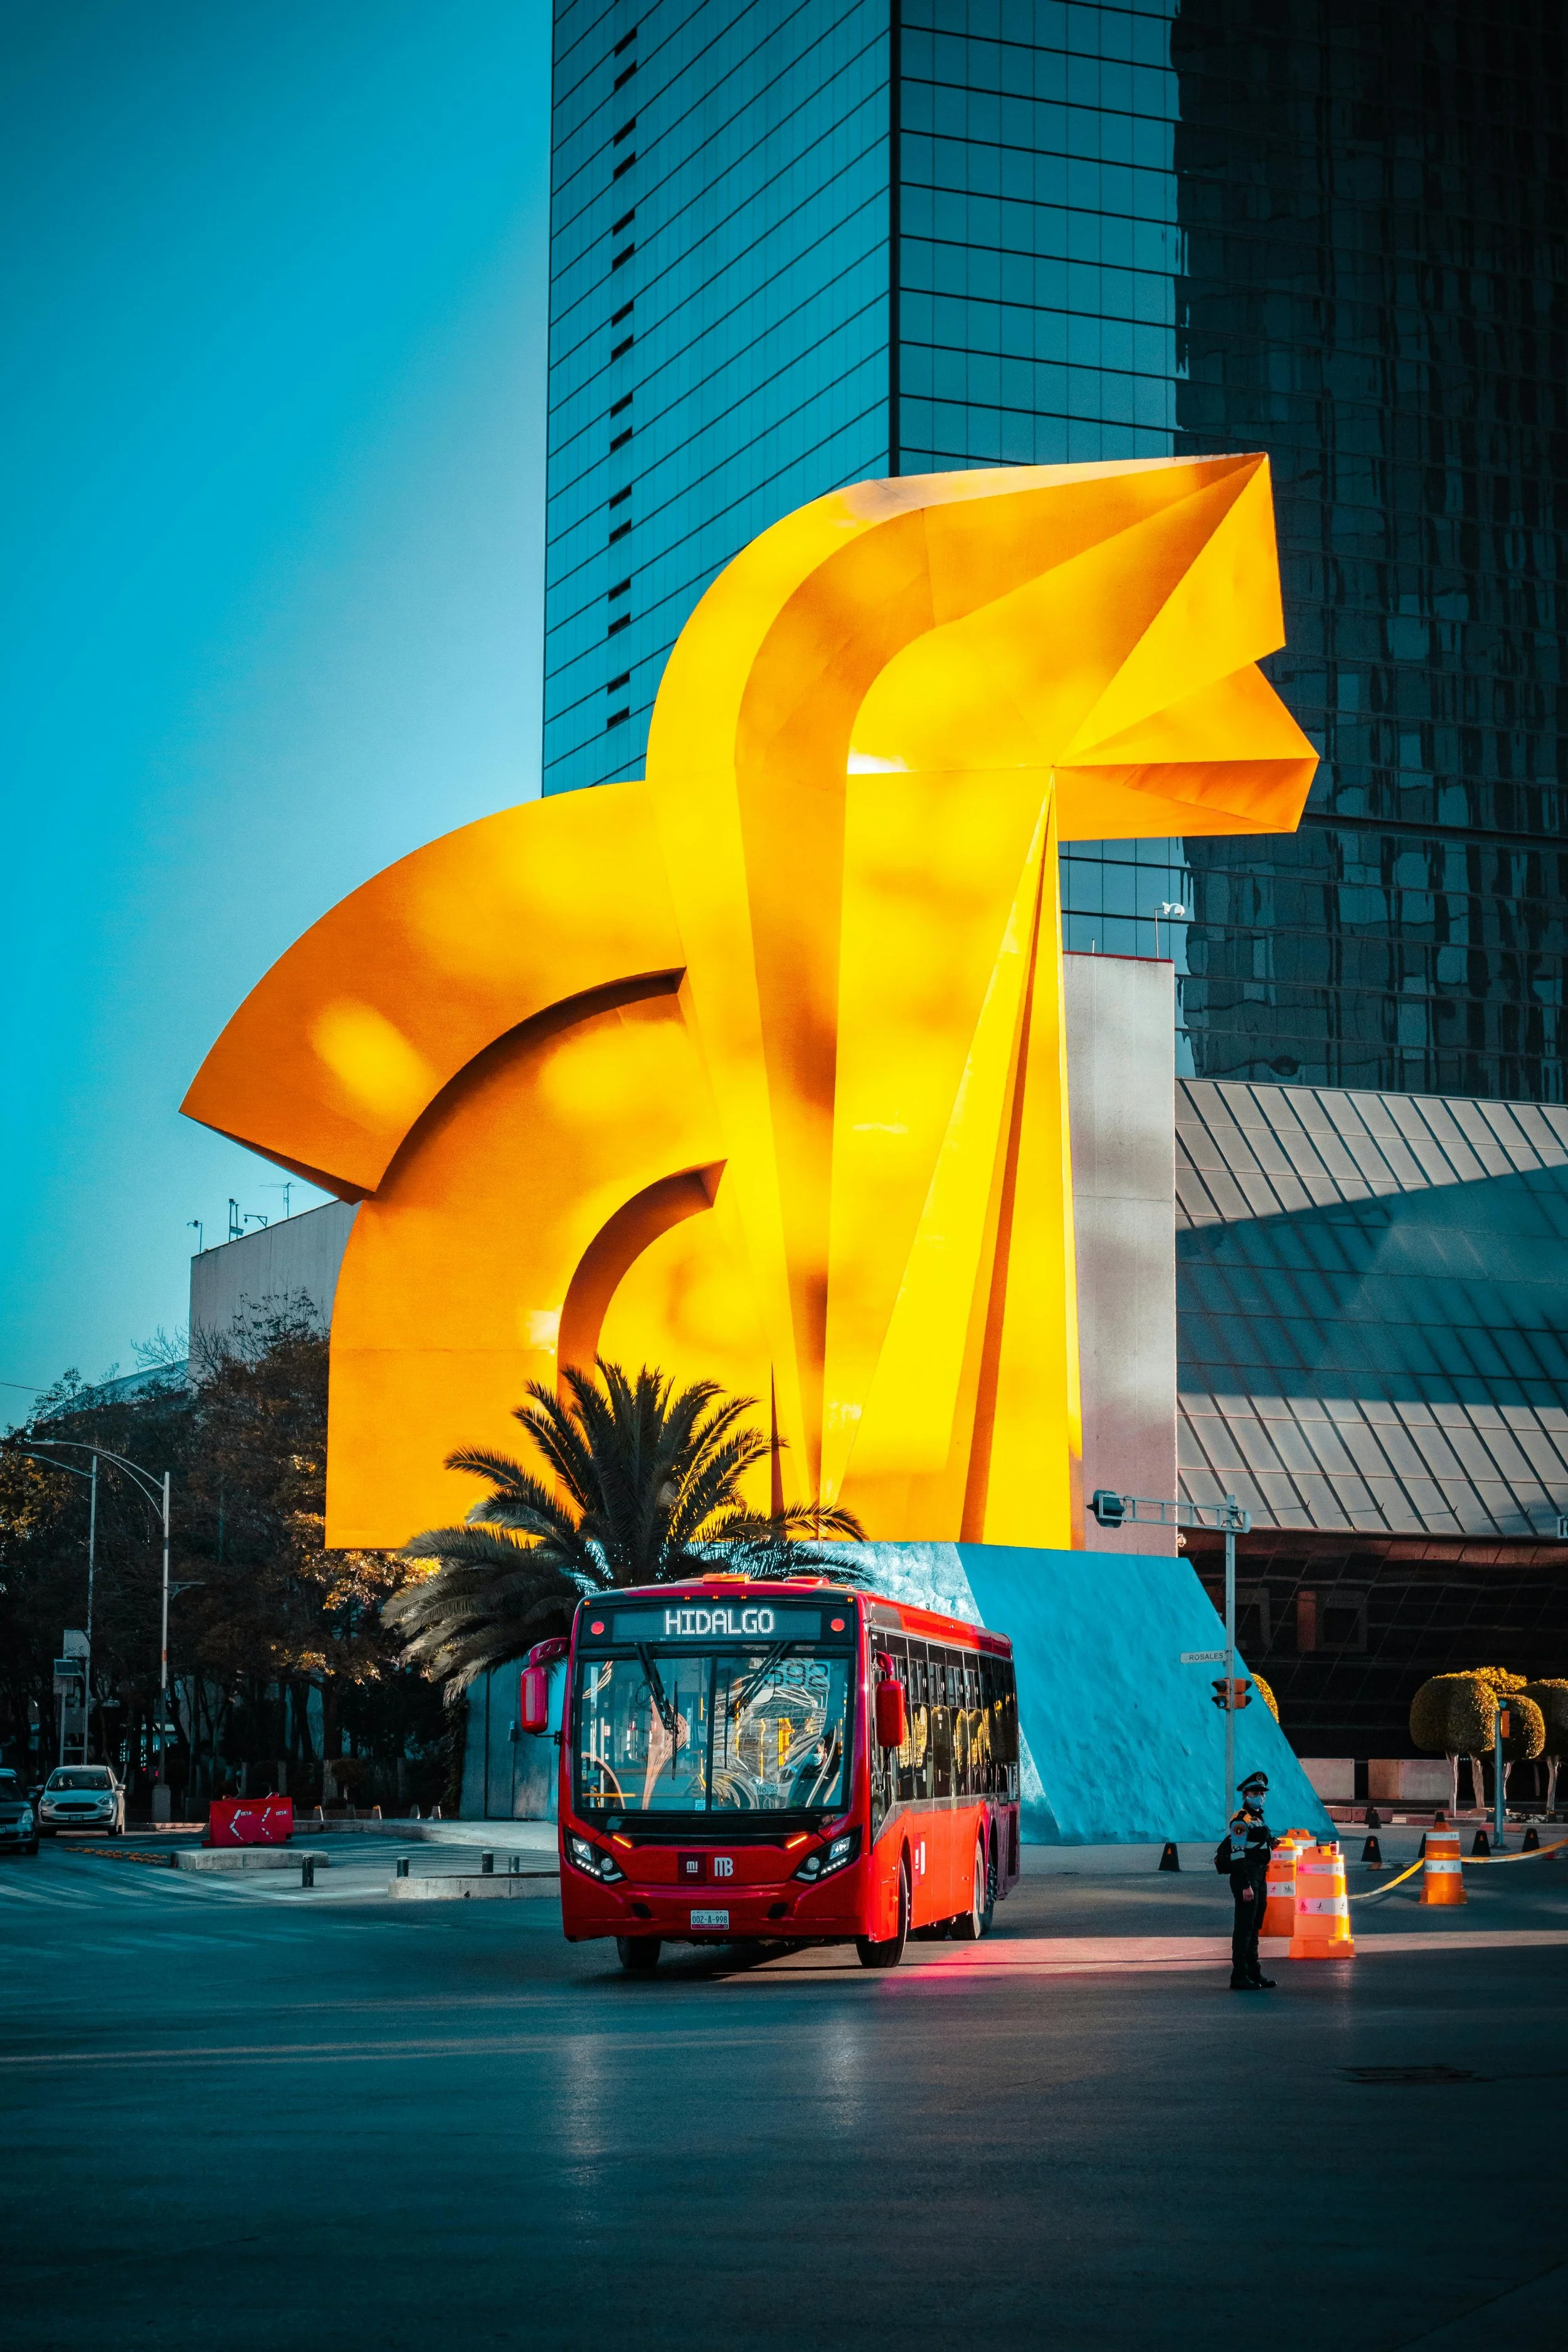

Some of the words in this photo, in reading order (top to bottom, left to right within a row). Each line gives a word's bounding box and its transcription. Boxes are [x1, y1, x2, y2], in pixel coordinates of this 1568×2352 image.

[665, 1609, 773, 1634] HIDALGO
[1189, 1653, 1224, 1661] ROSALES
[692, 1915, 728, 1924] 002-A-998
